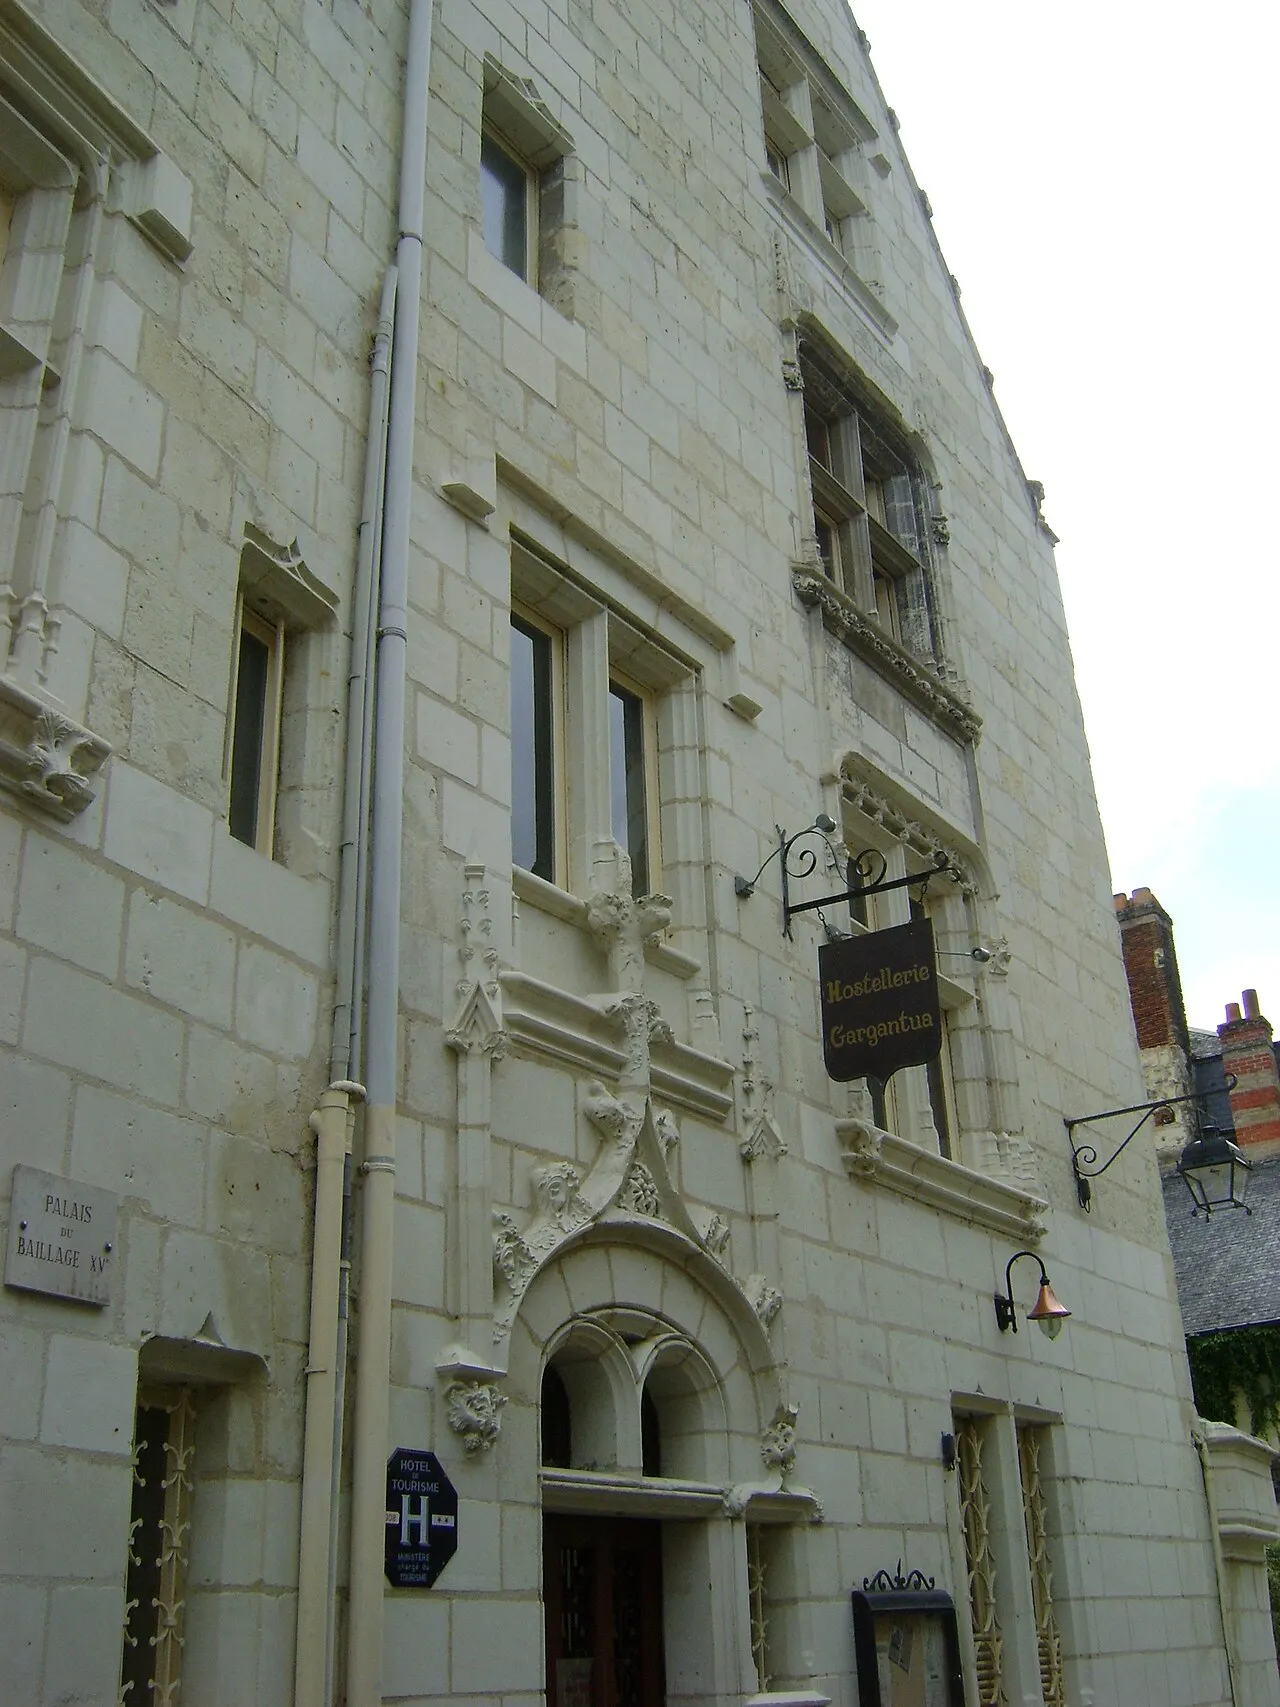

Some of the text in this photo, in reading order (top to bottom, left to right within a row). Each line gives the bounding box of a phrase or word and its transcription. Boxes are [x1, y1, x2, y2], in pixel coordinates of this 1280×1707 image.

[826, 963, 930, 1004] Hostellerie
[830, 1010, 934, 1048] Gargantua
[45, 1194, 92, 1224] PALAIS
[60, 1227, 74, 1239] DU
[16, 1236, 80, 1269] BAILLAGE
[391, 1479, 440, 1493] TOURISME
[400, 1494, 431, 1547] H
